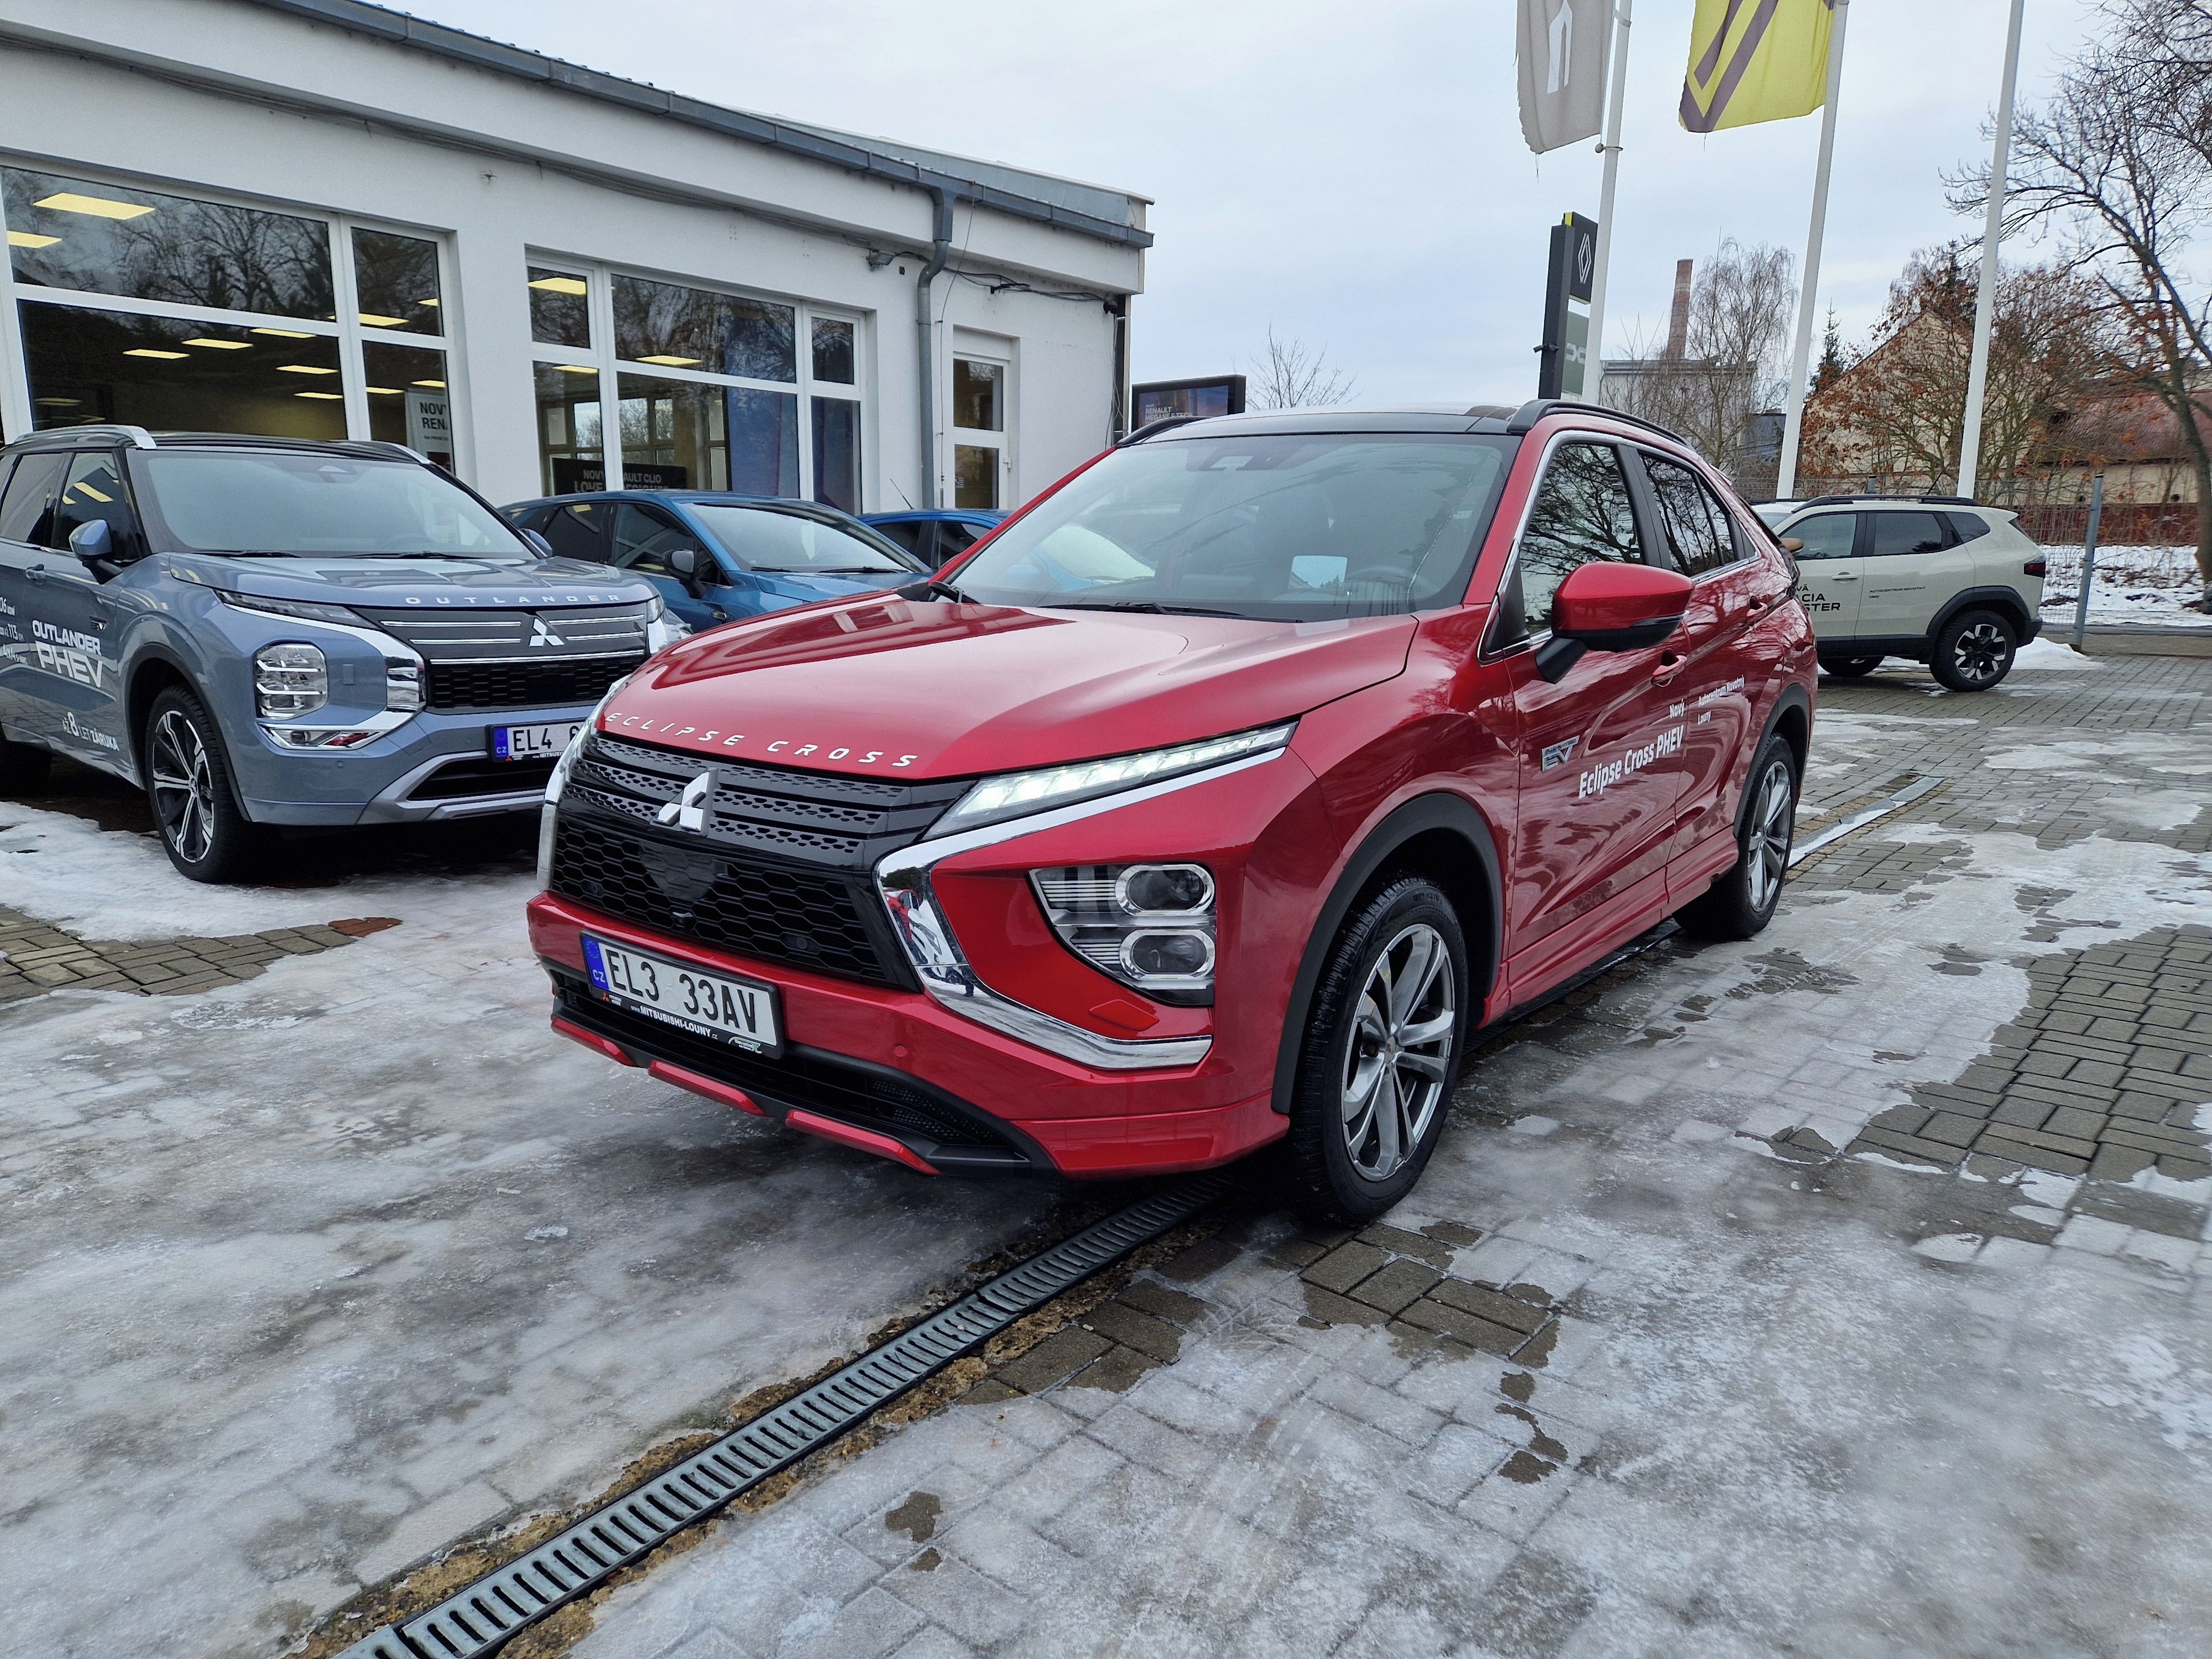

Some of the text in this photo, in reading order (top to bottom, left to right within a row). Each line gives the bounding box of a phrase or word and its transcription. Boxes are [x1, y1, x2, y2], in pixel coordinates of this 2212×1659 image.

[421, 417, 448, 430] REN
[643, 474, 661, 483] CLIO
[405, 594, 620, 605] OUTLANDER
[1796, 593, 1826, 602] CIA
[32, 619, 102, 656] OUTLANDER
[35, 640, 103, 688] PHEV
[1698, 674, 1744, 707] Autocentrum Novotný
[1670, 698, 1684, 718] Nový
[67, 711, 79, 737] 8
[90, 727, 119, 752] ZÁRUKA
[513, 728, 552, 752] EL4
[605, 712, 918, 766] ECLIPSE CROSS
[1542, 745, 1573, 772] EV
[1579, 724, 1684, 799] Eclipse Cross PHEV
[592, 969, 606, 983] CZ
[605, 948, 757, 1034] EL3 33AV
